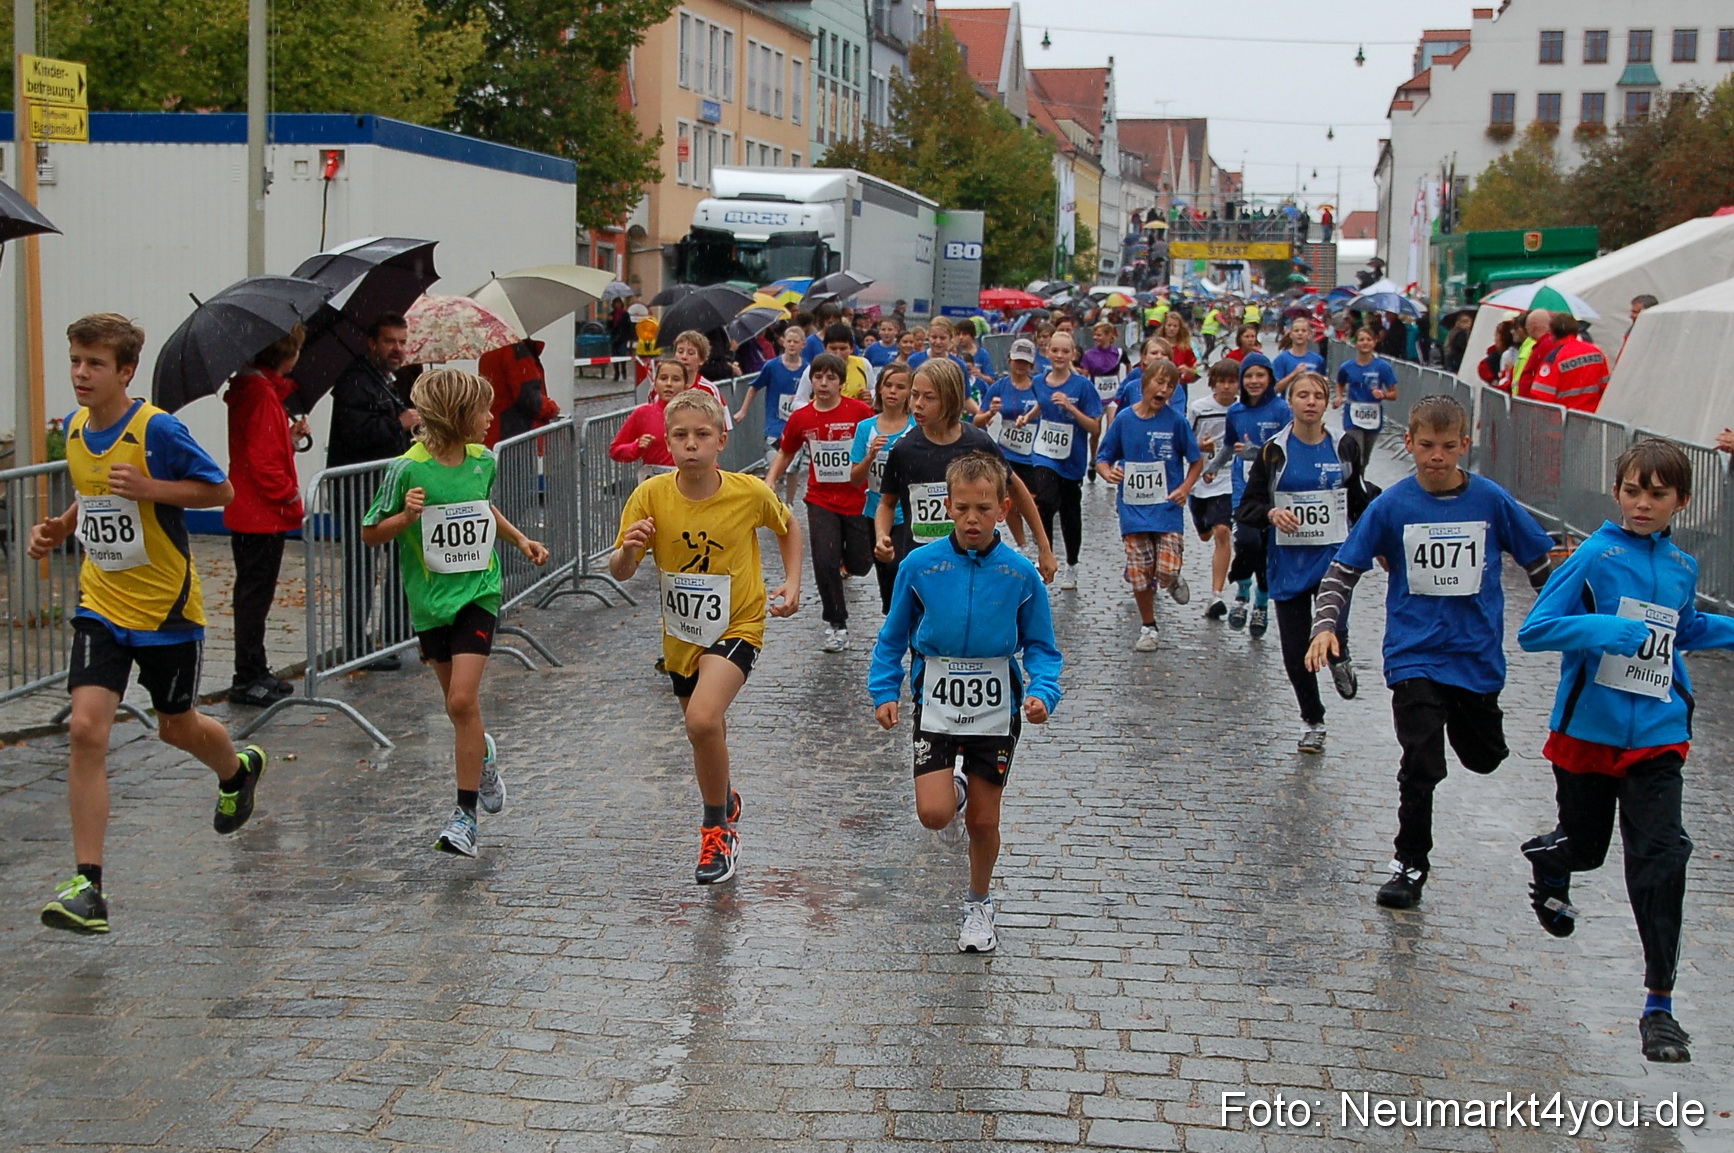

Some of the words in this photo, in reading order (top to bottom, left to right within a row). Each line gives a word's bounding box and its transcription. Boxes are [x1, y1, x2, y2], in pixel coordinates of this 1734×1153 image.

[33, 61, 69, 79] Kinder-
[27, 79, 76, 102] betreuung
[724, 210, 788, 226] BOCK
[943, 241, 983, 261] BO
[1207, 245, 1249, 256] START
[1560, 353, 1602, 371] NOTARZT
[1097, 382, 1117, 392] 4091
[1003, 428, 1033, 444] 4038
[1041, 430, 1069, 447] 4046
[813, 451, 851, 468] 4069
[1127, 473, 1163, 489] 4014
[1135, 492, 1155, 500] Albert
[445, 506, 474, 516] BOCK
[1284, 505, 1330, 526] 063
[81, 514, 136, 544] 4058
[430, 518, 490, 548] 4087
[1429, 527, 1461, 536] BOCK
[90, 548, 123, 561] Florian
[444, 550, 480, 563] Gabriel
[1413, 541, 1476, 569] 4071
[674, 577, 705, 587] BOCK
[1433, 575, 1459, 586] Luca
[666, 590, 722, 621] 4073
[1645, 608, 1674, 624] BOCK
[680, 621, 702, 636] Henri
[948, 662, 984, 671] BOCK
[1625, 665, 1670, 688] Philipp
[931, 677, 1002, 708] 4039
[954, 714, 975, 724] Jan
